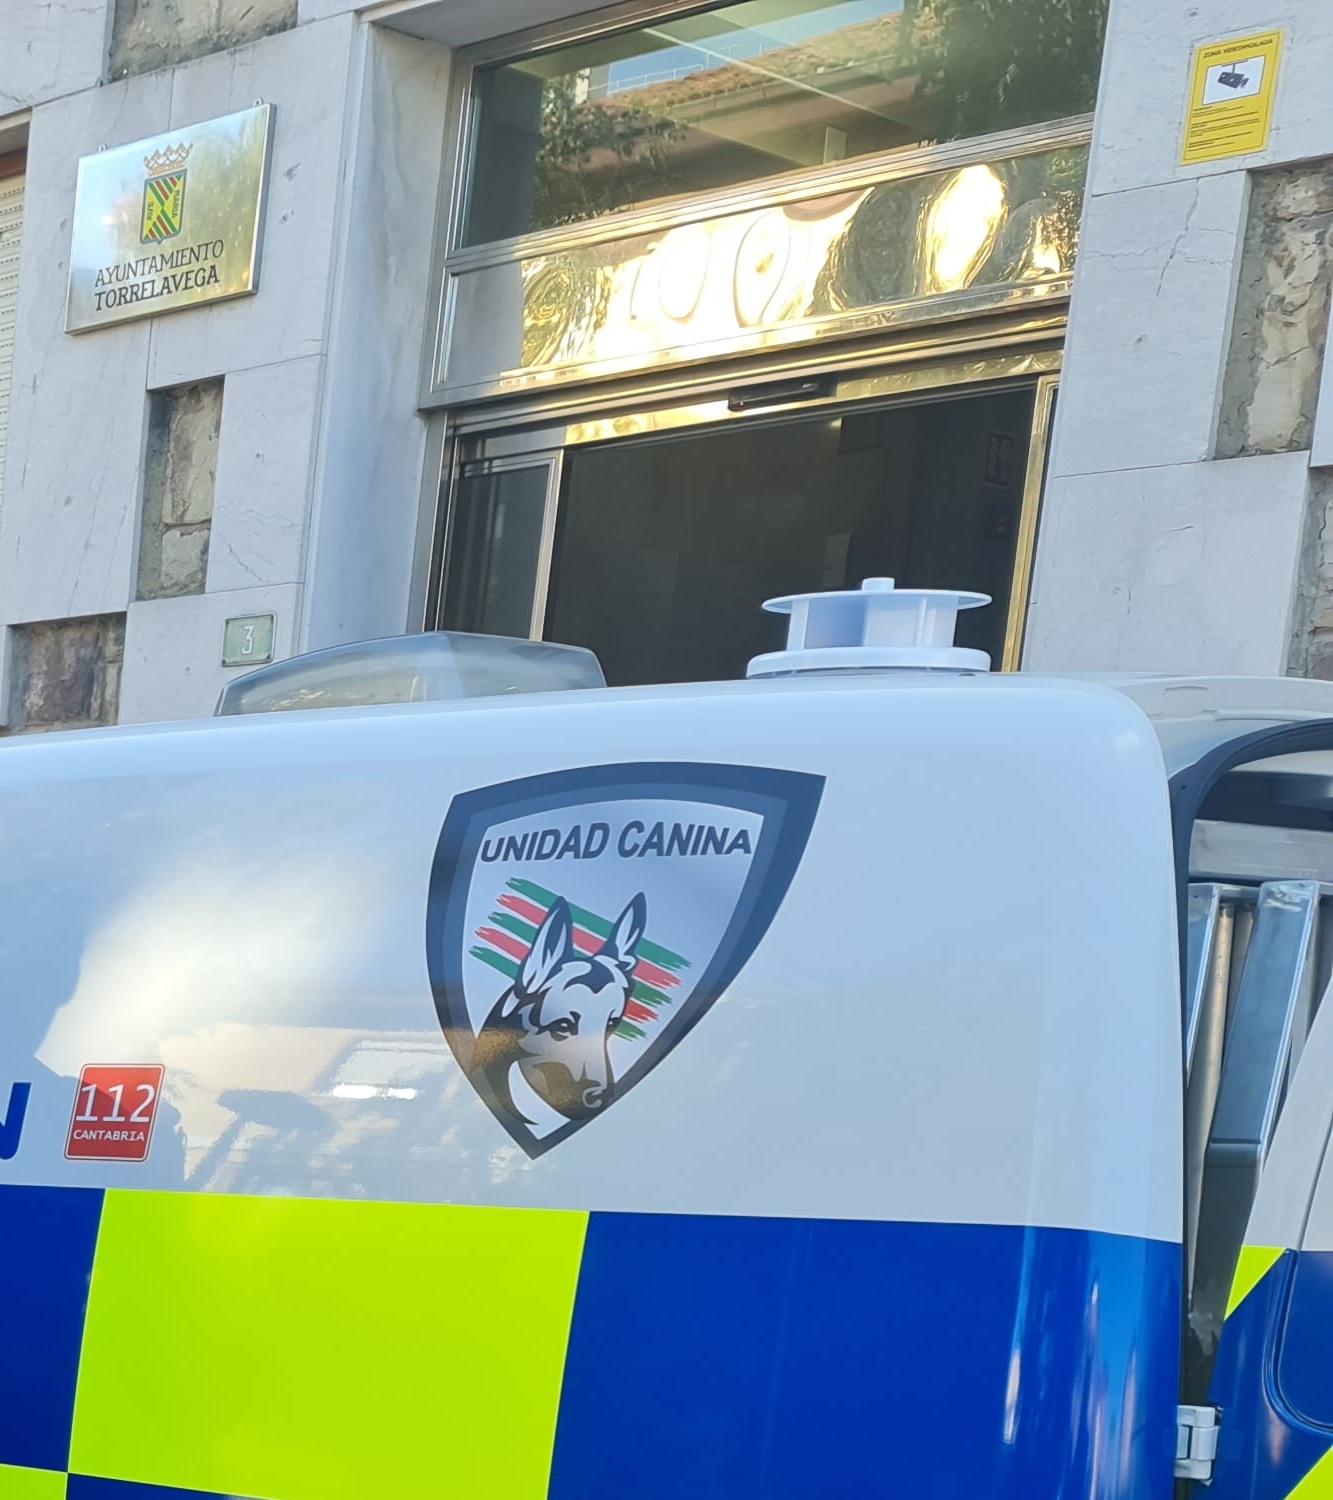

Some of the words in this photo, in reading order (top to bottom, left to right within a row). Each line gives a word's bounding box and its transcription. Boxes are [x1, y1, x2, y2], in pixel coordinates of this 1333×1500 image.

[94, 239, 224, 287] AYUNTAMIENTO
[94, 265, 221, 311] TORRELAVEGA
[241, 625, 255, 655] 3
[480, 822, 611, 862] UNIDAD
[617, 820, 753, 859] CANINA
[75, 1083, 156, 1123] 112
[73, 1129, 146, 1143] CANTABRIA
